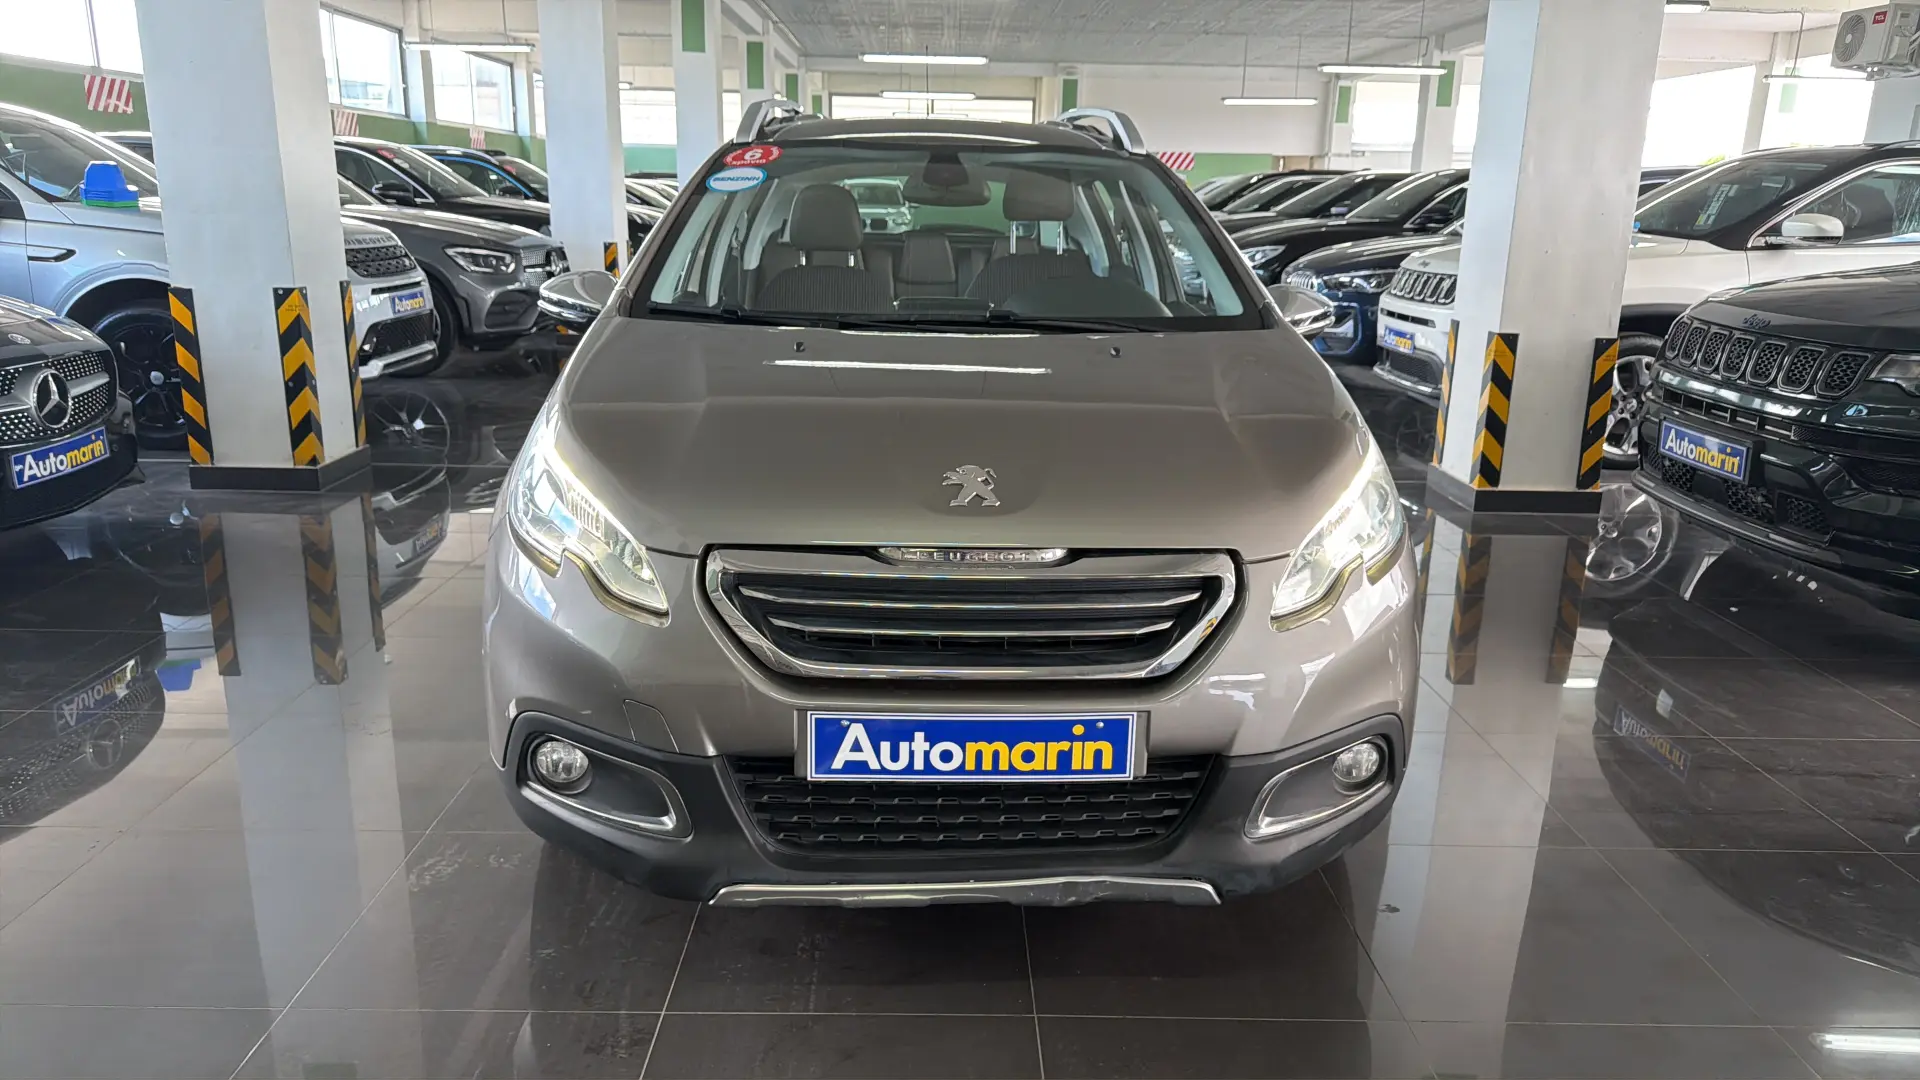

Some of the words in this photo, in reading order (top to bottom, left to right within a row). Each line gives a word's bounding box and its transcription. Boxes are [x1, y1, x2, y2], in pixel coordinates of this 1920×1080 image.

[744, 148, 763, 160] 6
[23, 434, 104, 481] Automarin
[1665, 428, 1739, 475] Automarin
[917, 551, 1030, 561] PEUGEOT
[831, 723, 1112, 771] Automarin
